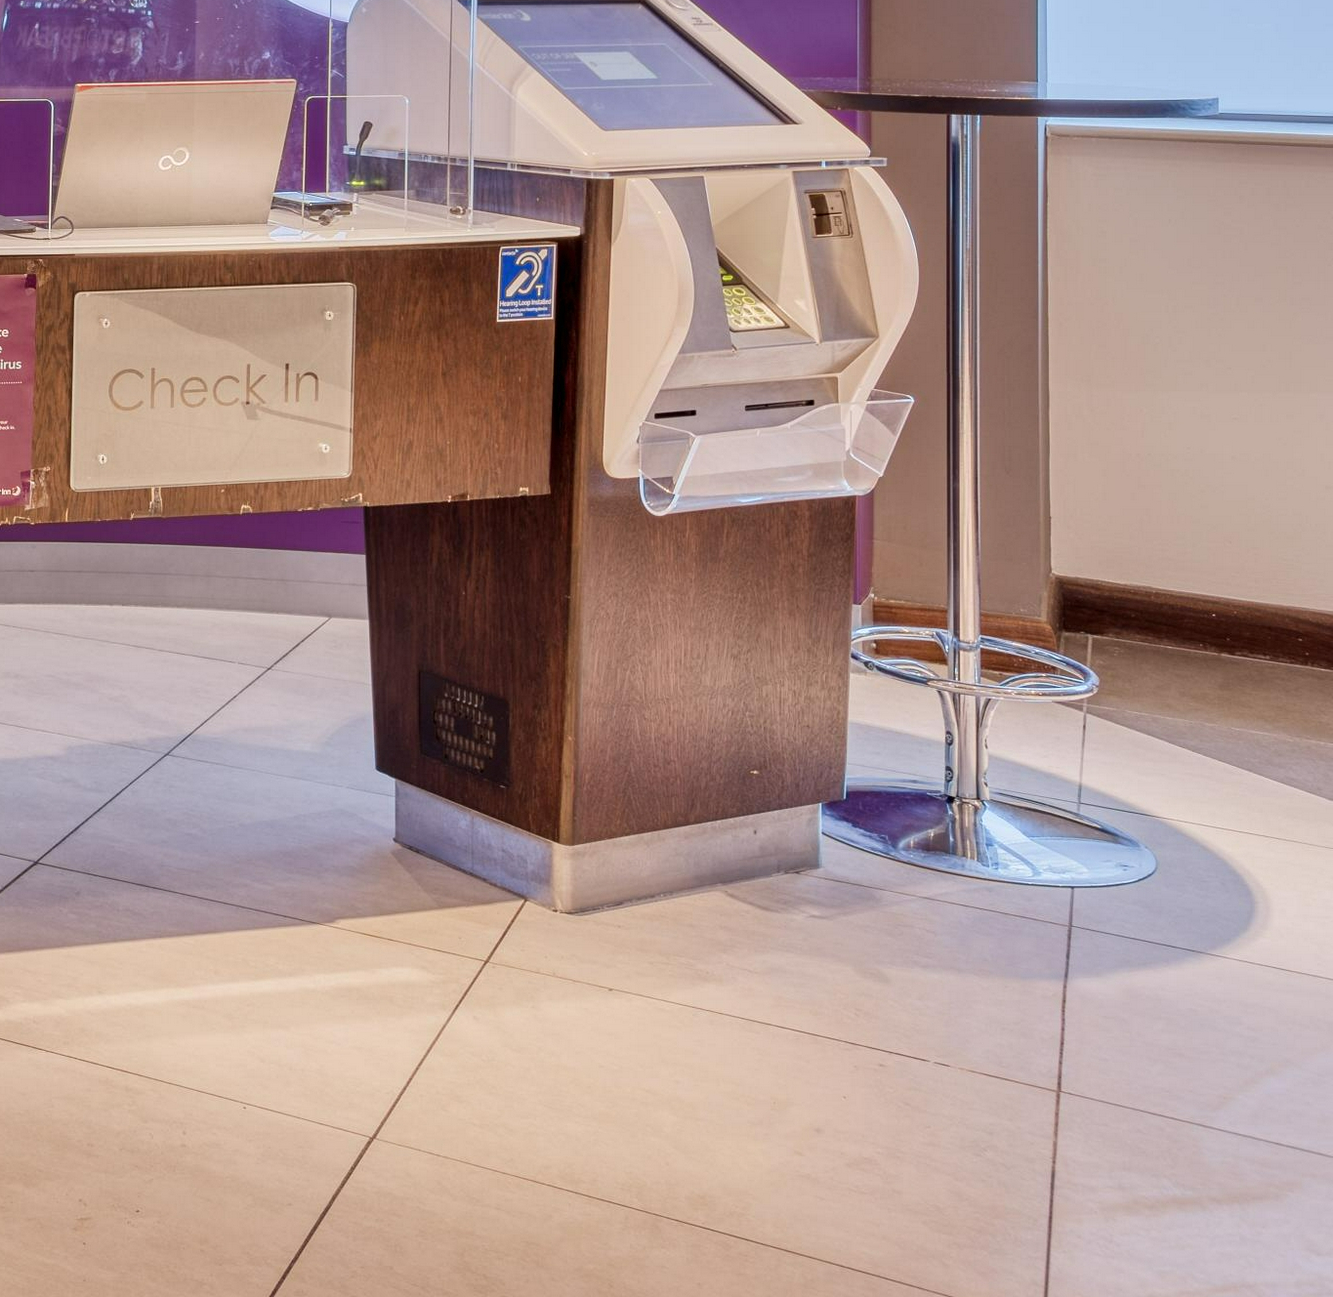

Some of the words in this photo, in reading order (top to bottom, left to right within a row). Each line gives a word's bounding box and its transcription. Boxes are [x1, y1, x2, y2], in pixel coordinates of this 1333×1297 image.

[535, 285, 544, 296] T
[108, 364, 267, 412] Check
[284, 363, 320, 403] In
